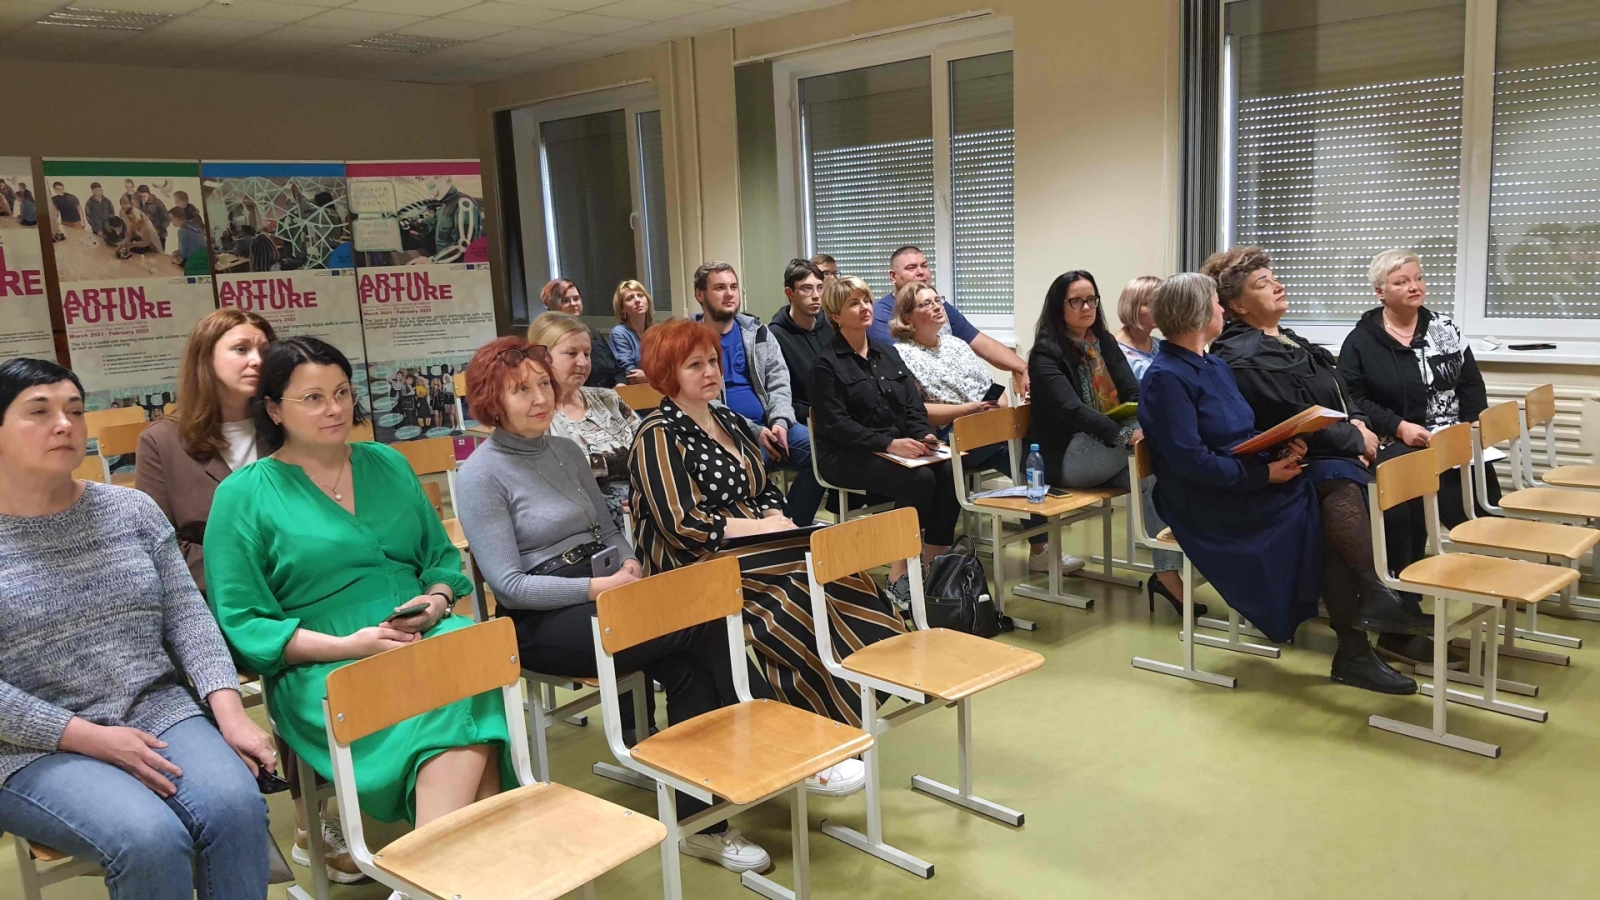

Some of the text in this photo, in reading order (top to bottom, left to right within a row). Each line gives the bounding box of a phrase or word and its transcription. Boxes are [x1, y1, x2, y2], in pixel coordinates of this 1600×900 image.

[220, 292, 318, 312] FUTURE
[360, 284, 452, 304] FUTURE
[65, 300, 172, 324] FUTURE
